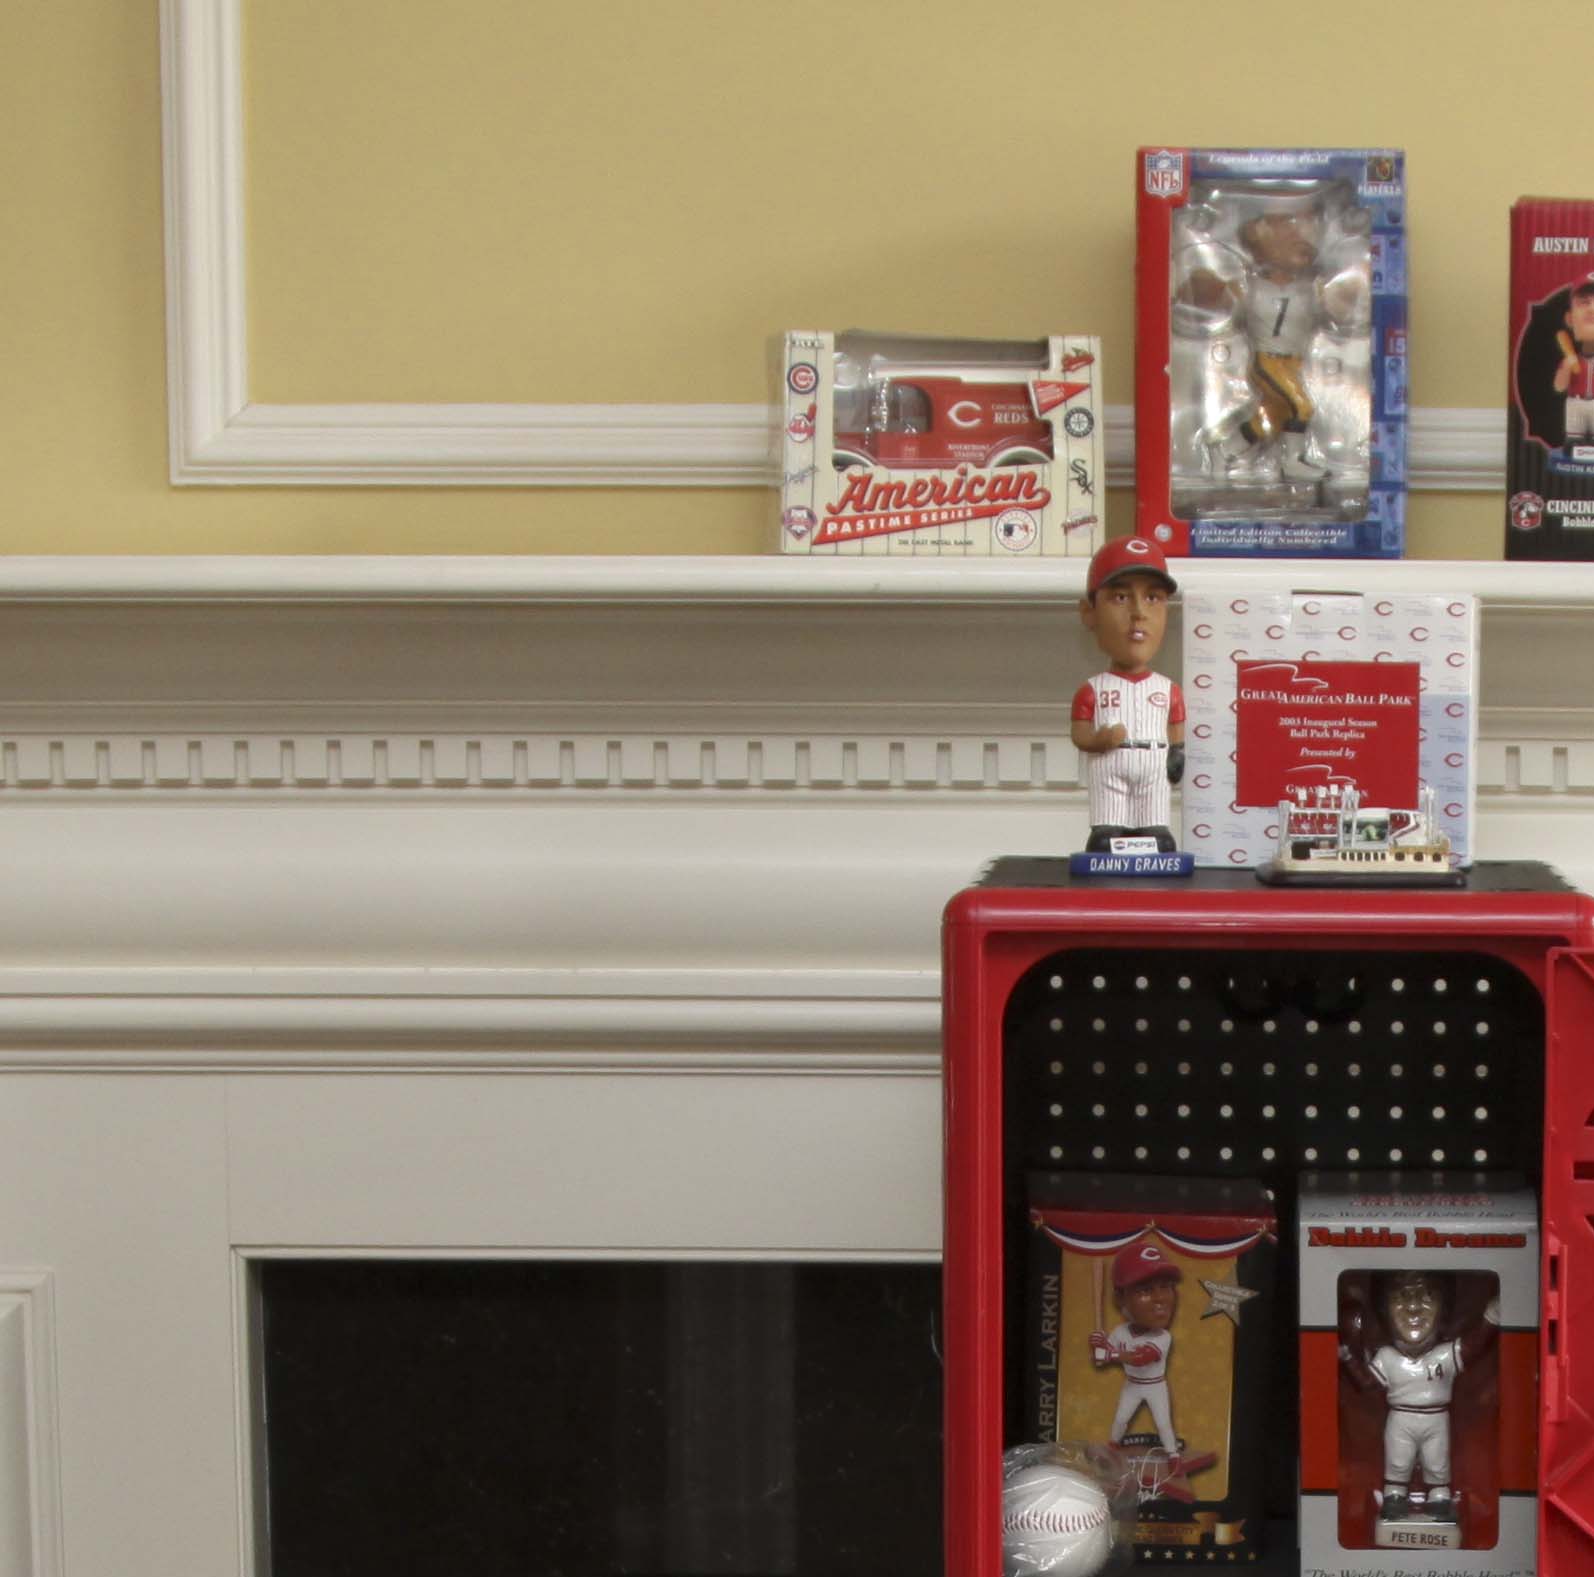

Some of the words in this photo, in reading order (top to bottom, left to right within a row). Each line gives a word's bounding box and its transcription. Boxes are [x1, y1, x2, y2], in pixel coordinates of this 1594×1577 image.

[1147, 168, 1180, 191] NFL
[1532, 237, 1589, 253] AUSTIN
[1271, 296, 1289, 338] 7
[993, 412, 1029, 424] REDS
[826, 468, 1051, 515] American
[826, 513, 912, 536] PASTIME
[920, 507, 974, 524] SERIES
[1099, 690, 1120, 708] 32
[1345, 693, 1376, 705] BALL
[1378, 693, 1412, 706] PARK
[1303, 717, 1346, 729] Inaugural
[1348, 718, 1377, 728] Season
[1290, 728, 1308, 738] Ball
[1310, 729, 1331, 739] Park
[1333, 730, 1365, 741] Replica
[1300, 747, 1343, 758] Presented
[1345, 748, 1357, 760] by
[1126, 840, 1156, 849] PEPSI
[1090, 857, 1129, 872] DANNY
[1135, 858, 1181, 872] GRAVES
[1414, 1227, 1527, 1248] Dreams
[1038, 1274, 1059, 1371] LARKIN
[1427, 1363, 1444, 1381] 14
[1038, 1377, 1056, 1442] ARRY
[1392, 1532, 1416, 1544] PETE
[1420, 1534, 1448, 1547] ROSE
